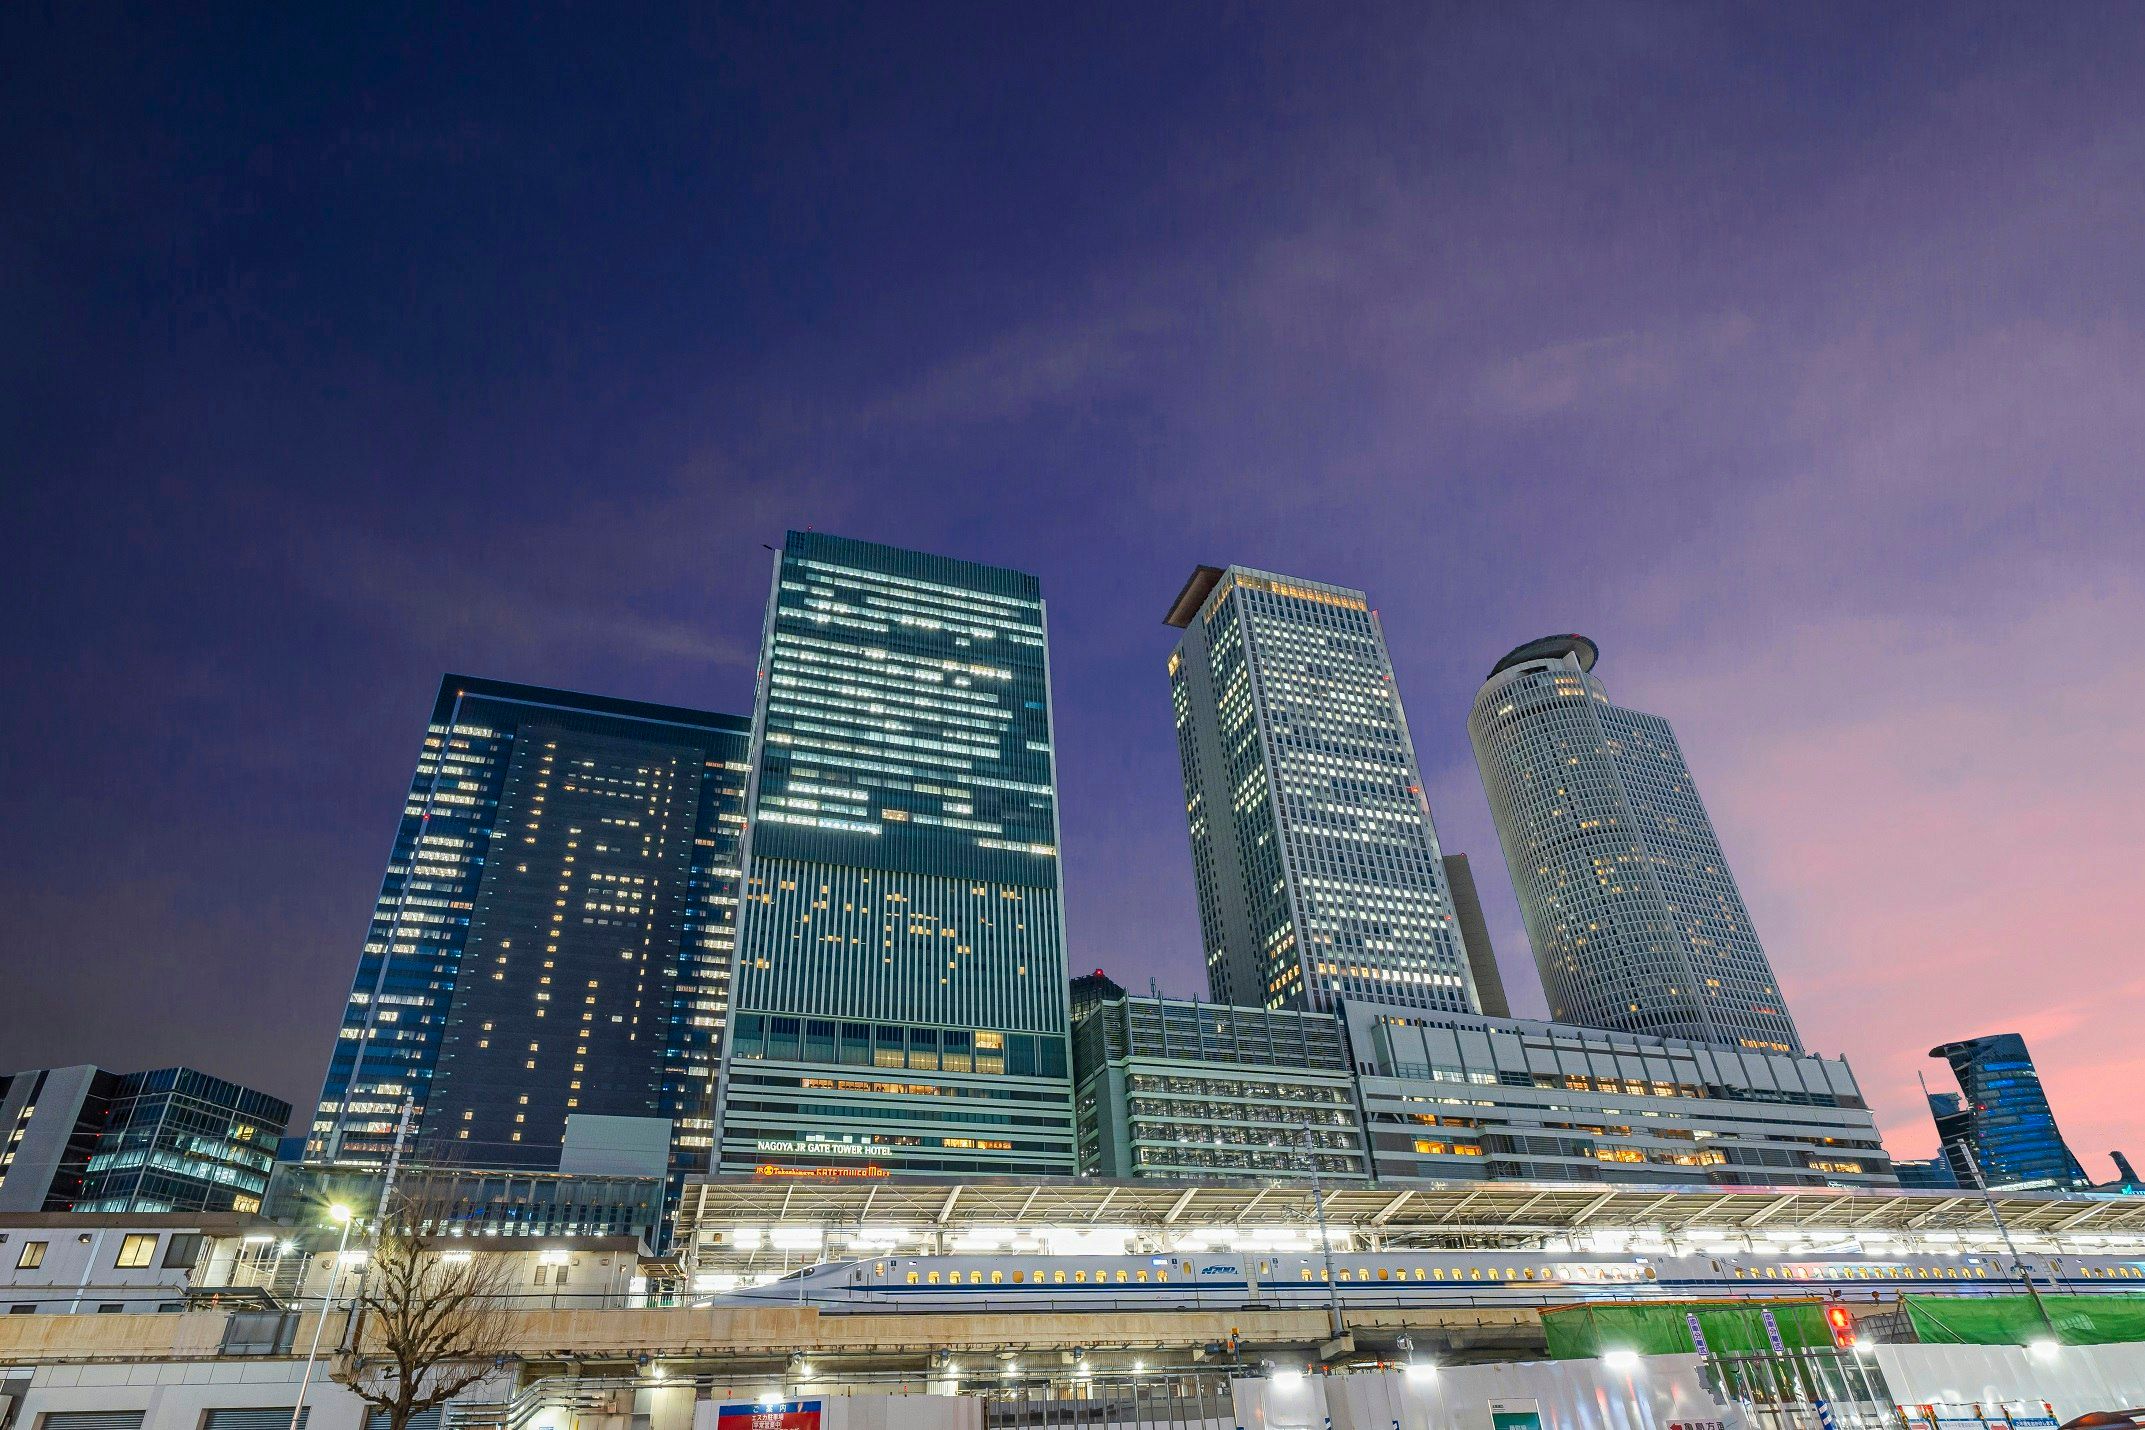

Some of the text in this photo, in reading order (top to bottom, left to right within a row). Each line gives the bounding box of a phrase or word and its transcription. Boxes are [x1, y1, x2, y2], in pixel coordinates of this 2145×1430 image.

[757, 1141, 893, 1156] NAGOYA JR GATE TOWER HOTEL
